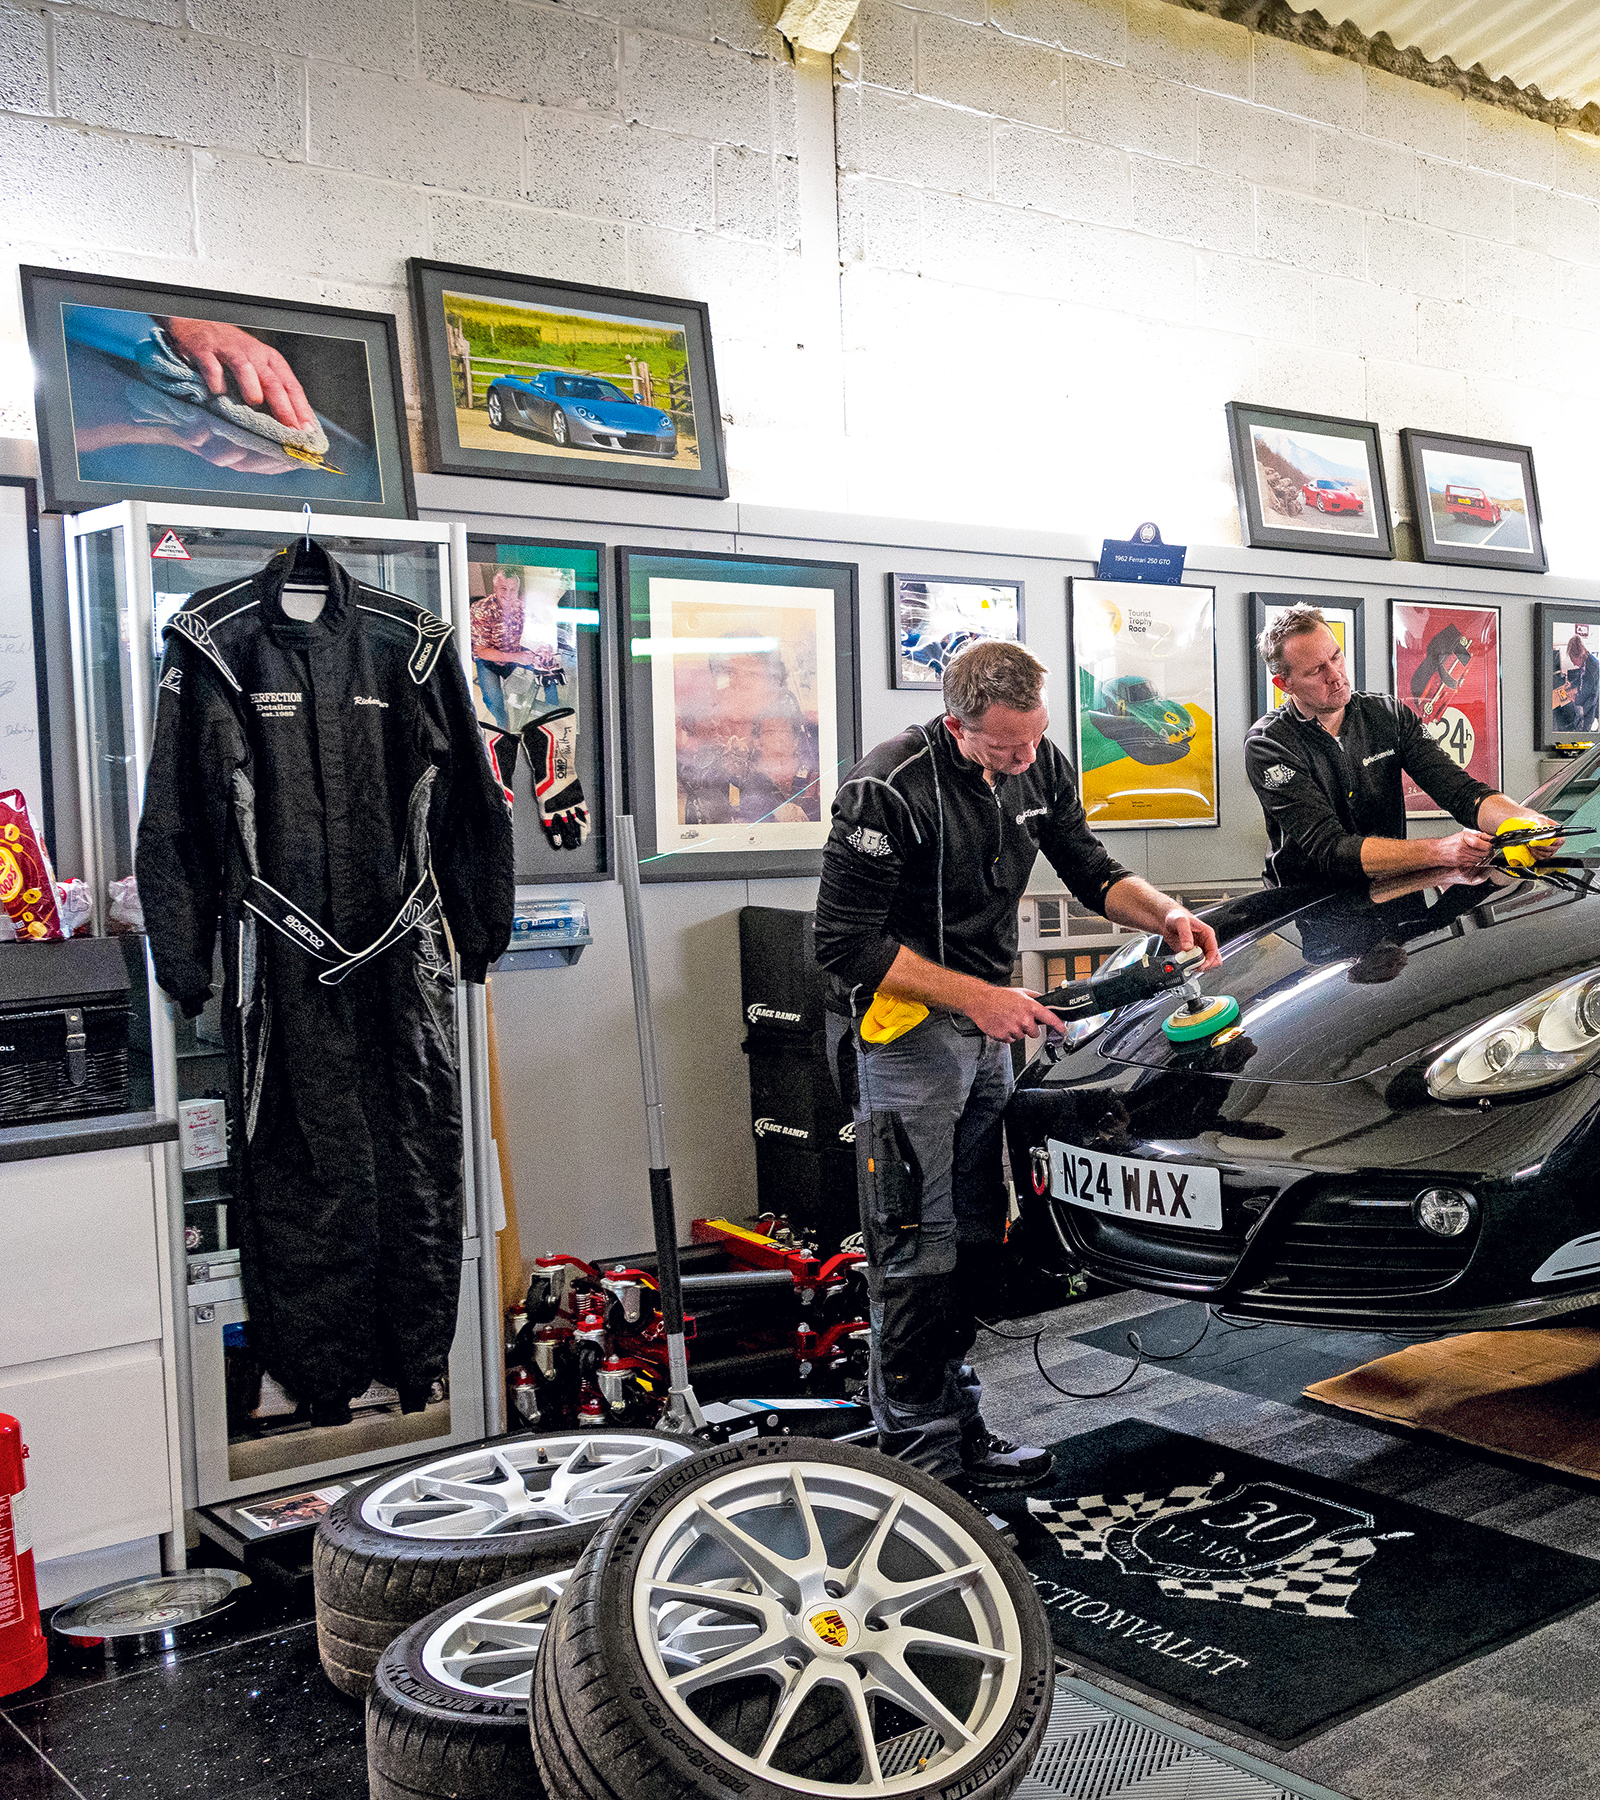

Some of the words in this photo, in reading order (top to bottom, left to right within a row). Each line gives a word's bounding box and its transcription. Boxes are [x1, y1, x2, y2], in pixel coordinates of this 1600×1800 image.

[1128, 609, 1152, 618] Tourist
[1128, 617, 1152, 627] Trophy
[1129, 625, 1147, 633] Race
[415, 642, 434, 672] sparco
[556, 759, 567, 779] OMP
[283, 914, 325, 949] sparco
[756, 1008, 775, 1018] RACE
[774, 1010, 801, 1022] RAMPS
[1069, 993, 1091, 1005] RUPES
[763, 1122, 783, 1133] RACE
[782, 1126, 809, 1139] RAMPS
[1063, 1151, 1112, 1206] N24
[1121, 1165, 1192, 1219] WAX
[653, 1448, 741, 1503] MICHELIN
[1201, 1500, 1317, 1542] 30
[1157, 1523, 1257, 1566] YEARS
[1028, 1571, 1249, 1676] CTIONVALET
[396, 1677, 478, 1713] MICHELIN
[661, 1728, 709, 1768] Sport
[704, 1763, 750, 1794] Pilot
[945, 1730, 1025, 1800] MICHELIN
